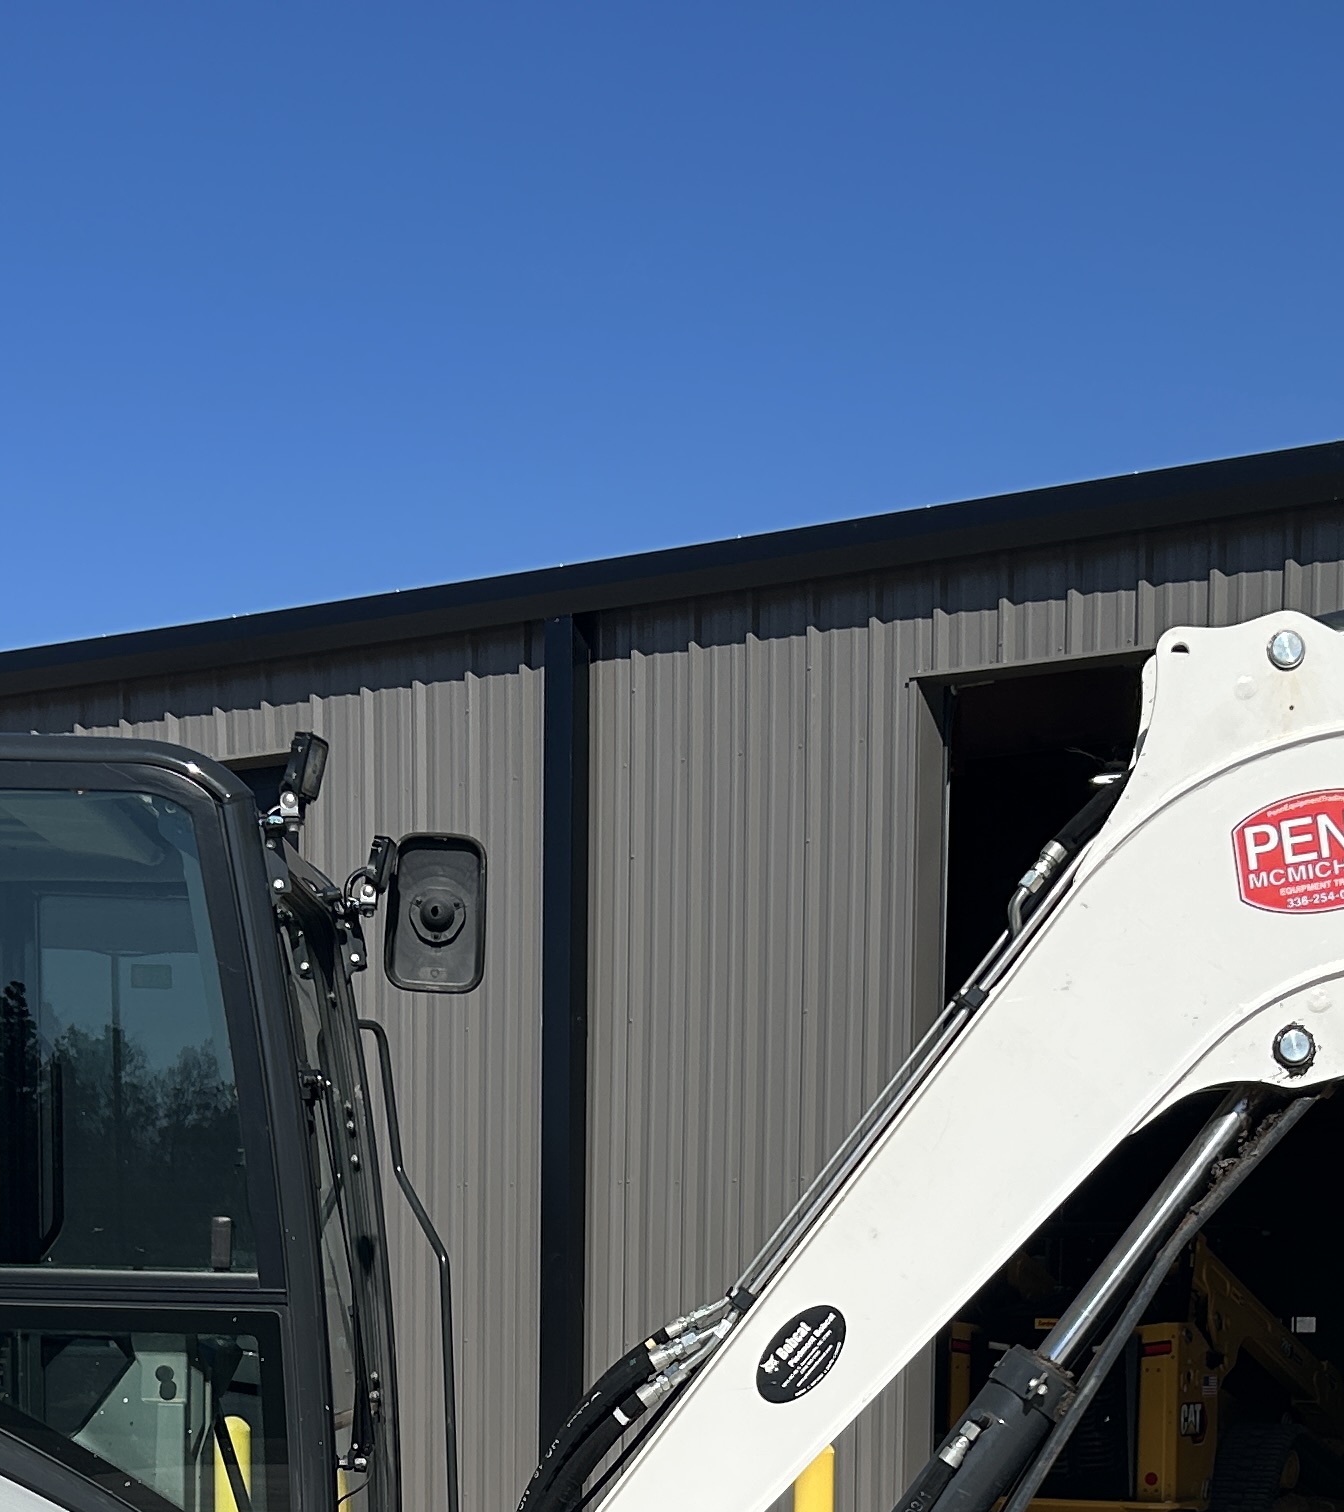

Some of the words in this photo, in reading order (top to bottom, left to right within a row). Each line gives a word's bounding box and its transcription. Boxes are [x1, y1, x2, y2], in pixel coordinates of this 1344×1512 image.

[1279, 880, 1332, 896] EQUIPMENT
[775, 1321, 812, 1360] Bobcat
[1180, 1403, 1202, 1435] CAT
